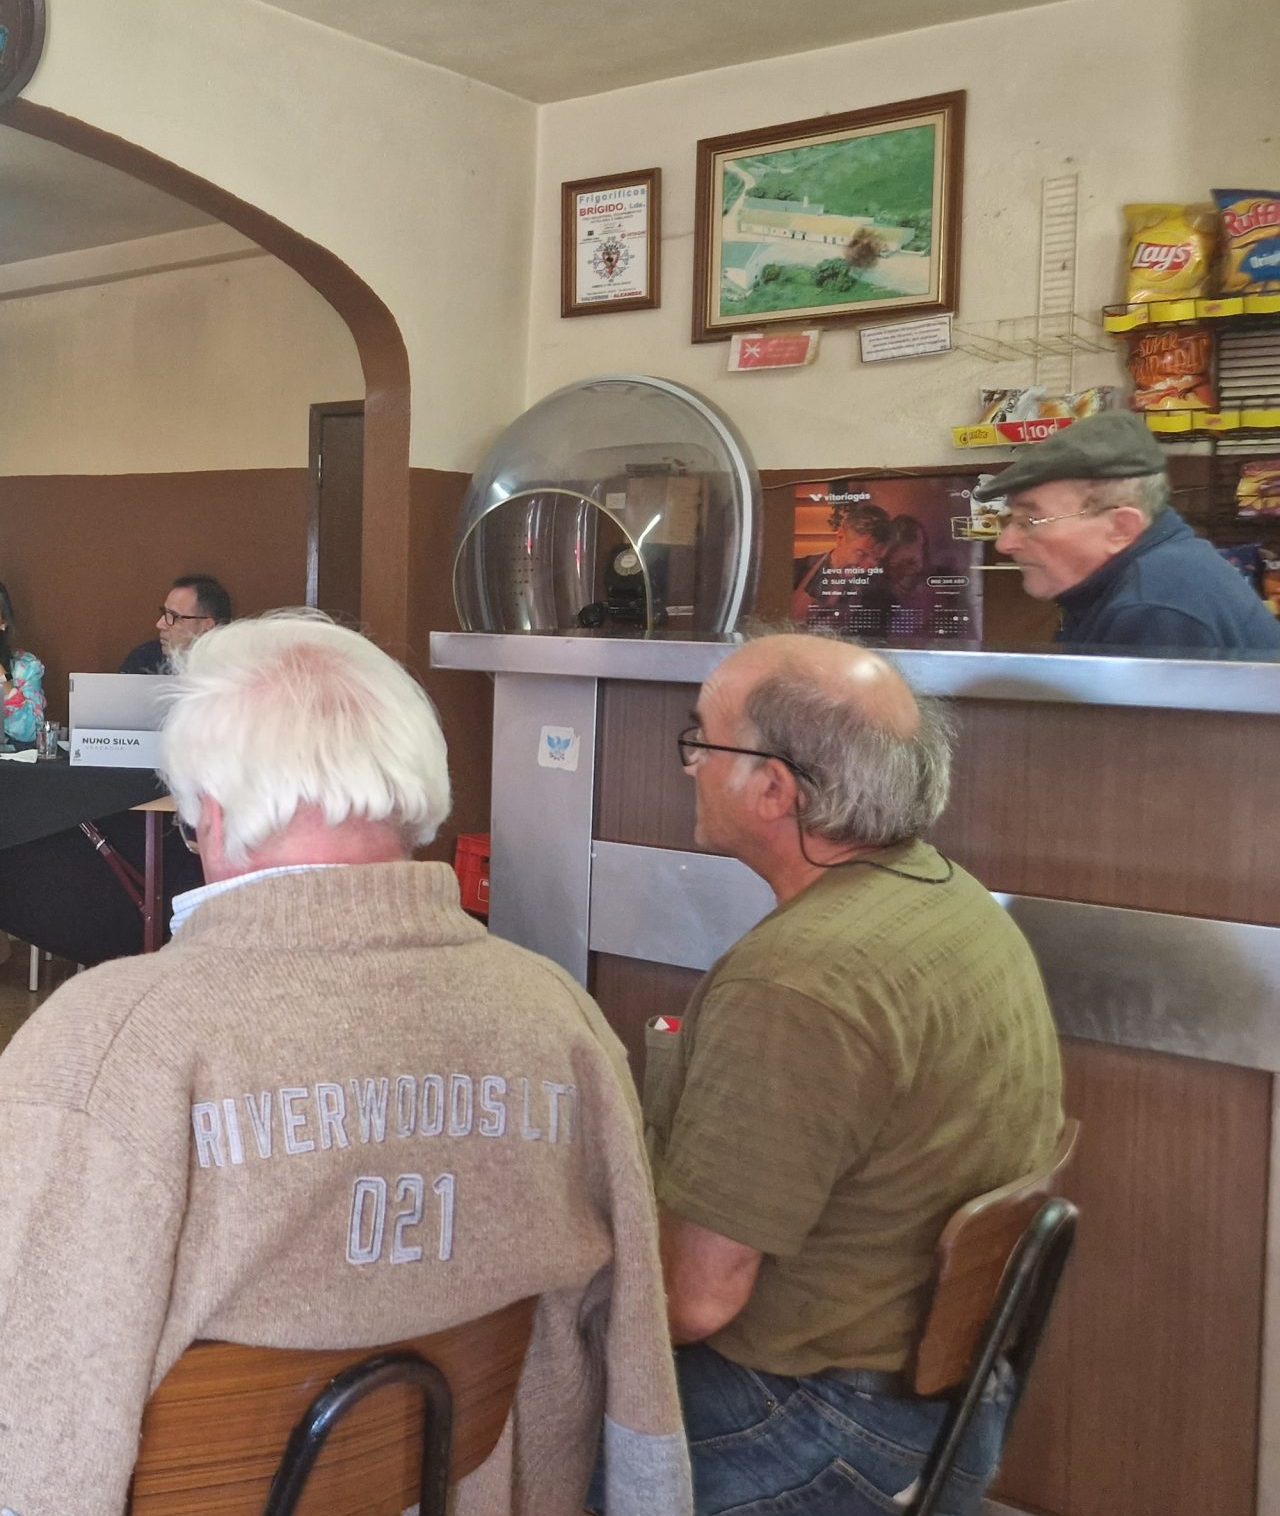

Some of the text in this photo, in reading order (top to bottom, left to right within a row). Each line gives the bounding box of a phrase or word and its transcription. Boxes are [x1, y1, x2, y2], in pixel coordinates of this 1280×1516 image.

[822, 566, 884, 576] Leva mais gás
[848, 576, 870, 585] vida!
[82, 737, 140, 746] NUNO SILVA
[192, 1073, 508, 1169] RIVERWOODS
[345, 1172, 456, 1266] 021
